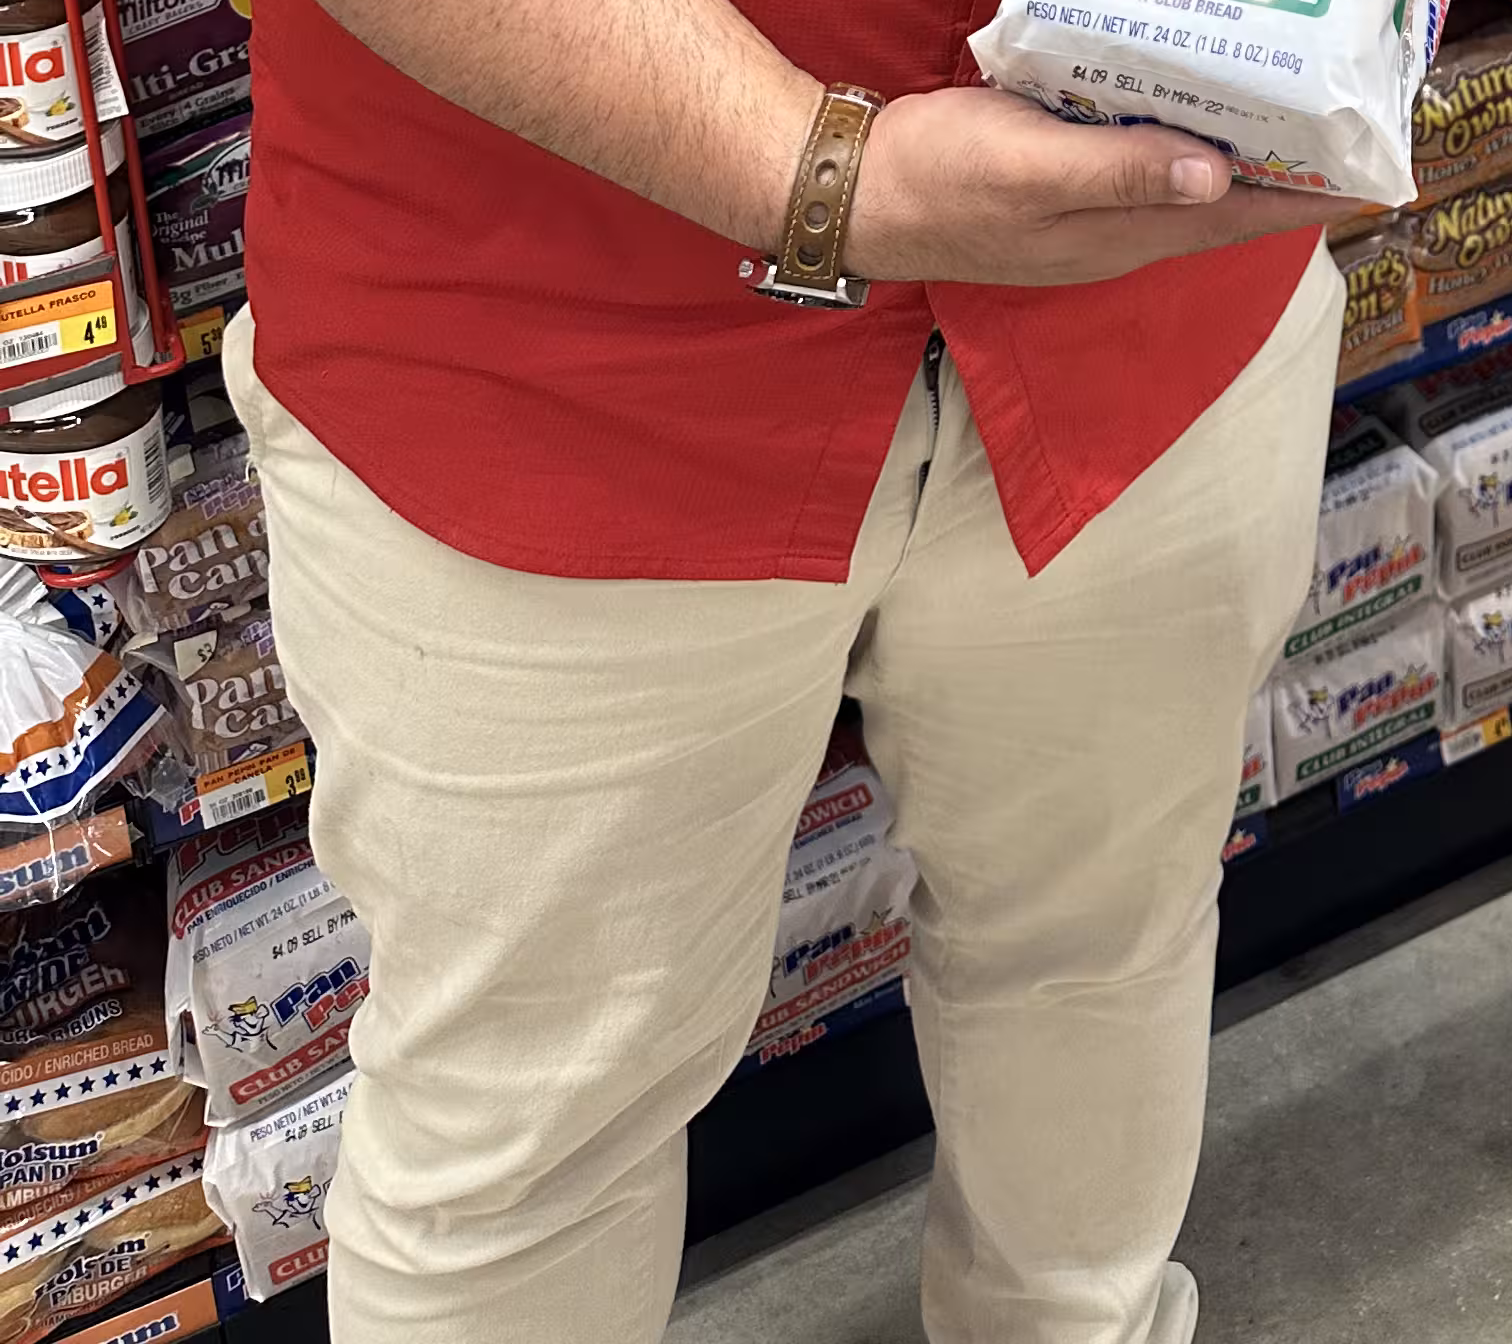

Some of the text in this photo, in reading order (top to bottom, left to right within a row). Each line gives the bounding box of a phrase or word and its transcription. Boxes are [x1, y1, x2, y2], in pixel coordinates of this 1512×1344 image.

[1195, 0, 1244, 22] BREAD
[1027, 0, 1304, 75] PESO NETO NET WT. 24 OZ. 680g
[1115, 73, 1173, 100] SELL BY
[49, 289, 97, 310] FRASCO
[139, 519, 240, 594] Pan
[271, 956, 362, 1027] Pan
[45, 1032, 154, 1077] ENRICHED BREAD
[238, 1057, 303, 1098] CLUB
